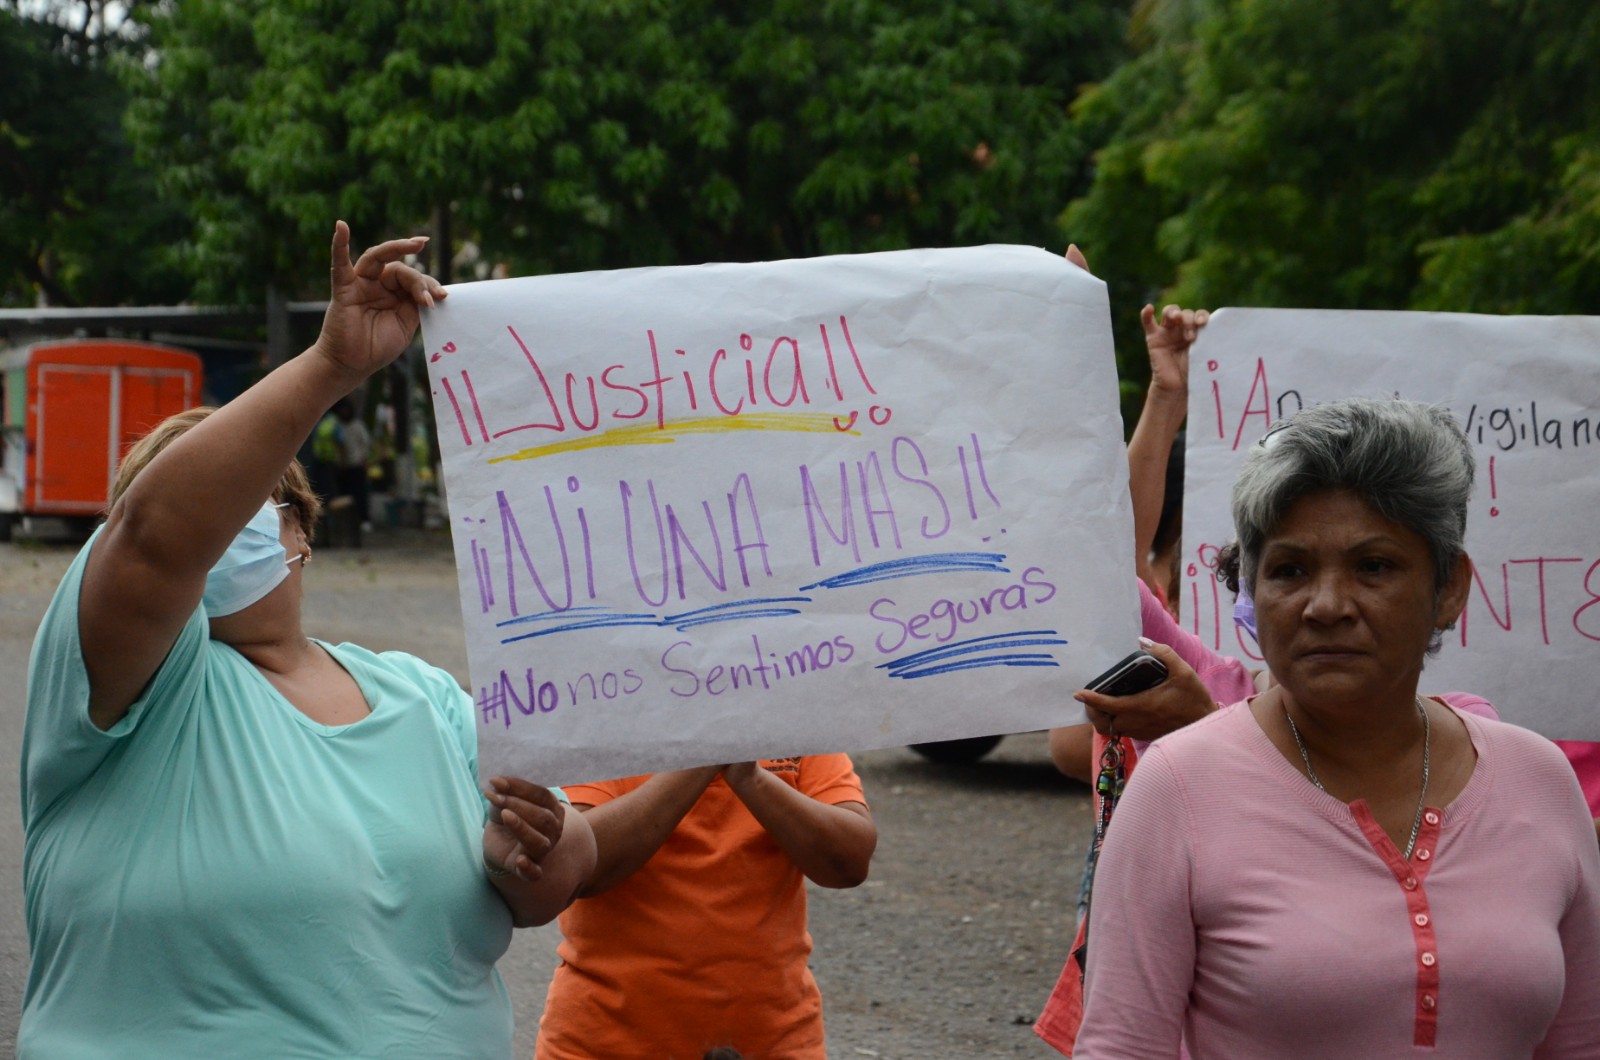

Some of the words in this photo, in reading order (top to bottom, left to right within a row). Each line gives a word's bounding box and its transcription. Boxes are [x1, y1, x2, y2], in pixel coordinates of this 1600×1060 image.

[1465, 401, 1600, 450] igilan
[619, 472, 773, 608] UNA
[800, 432, 1007, 567] MAS!!
[477, 669, 559, 729] #No
[569, 665, 643, 706] nos
[661, 634, 855, 698] Sentimos
